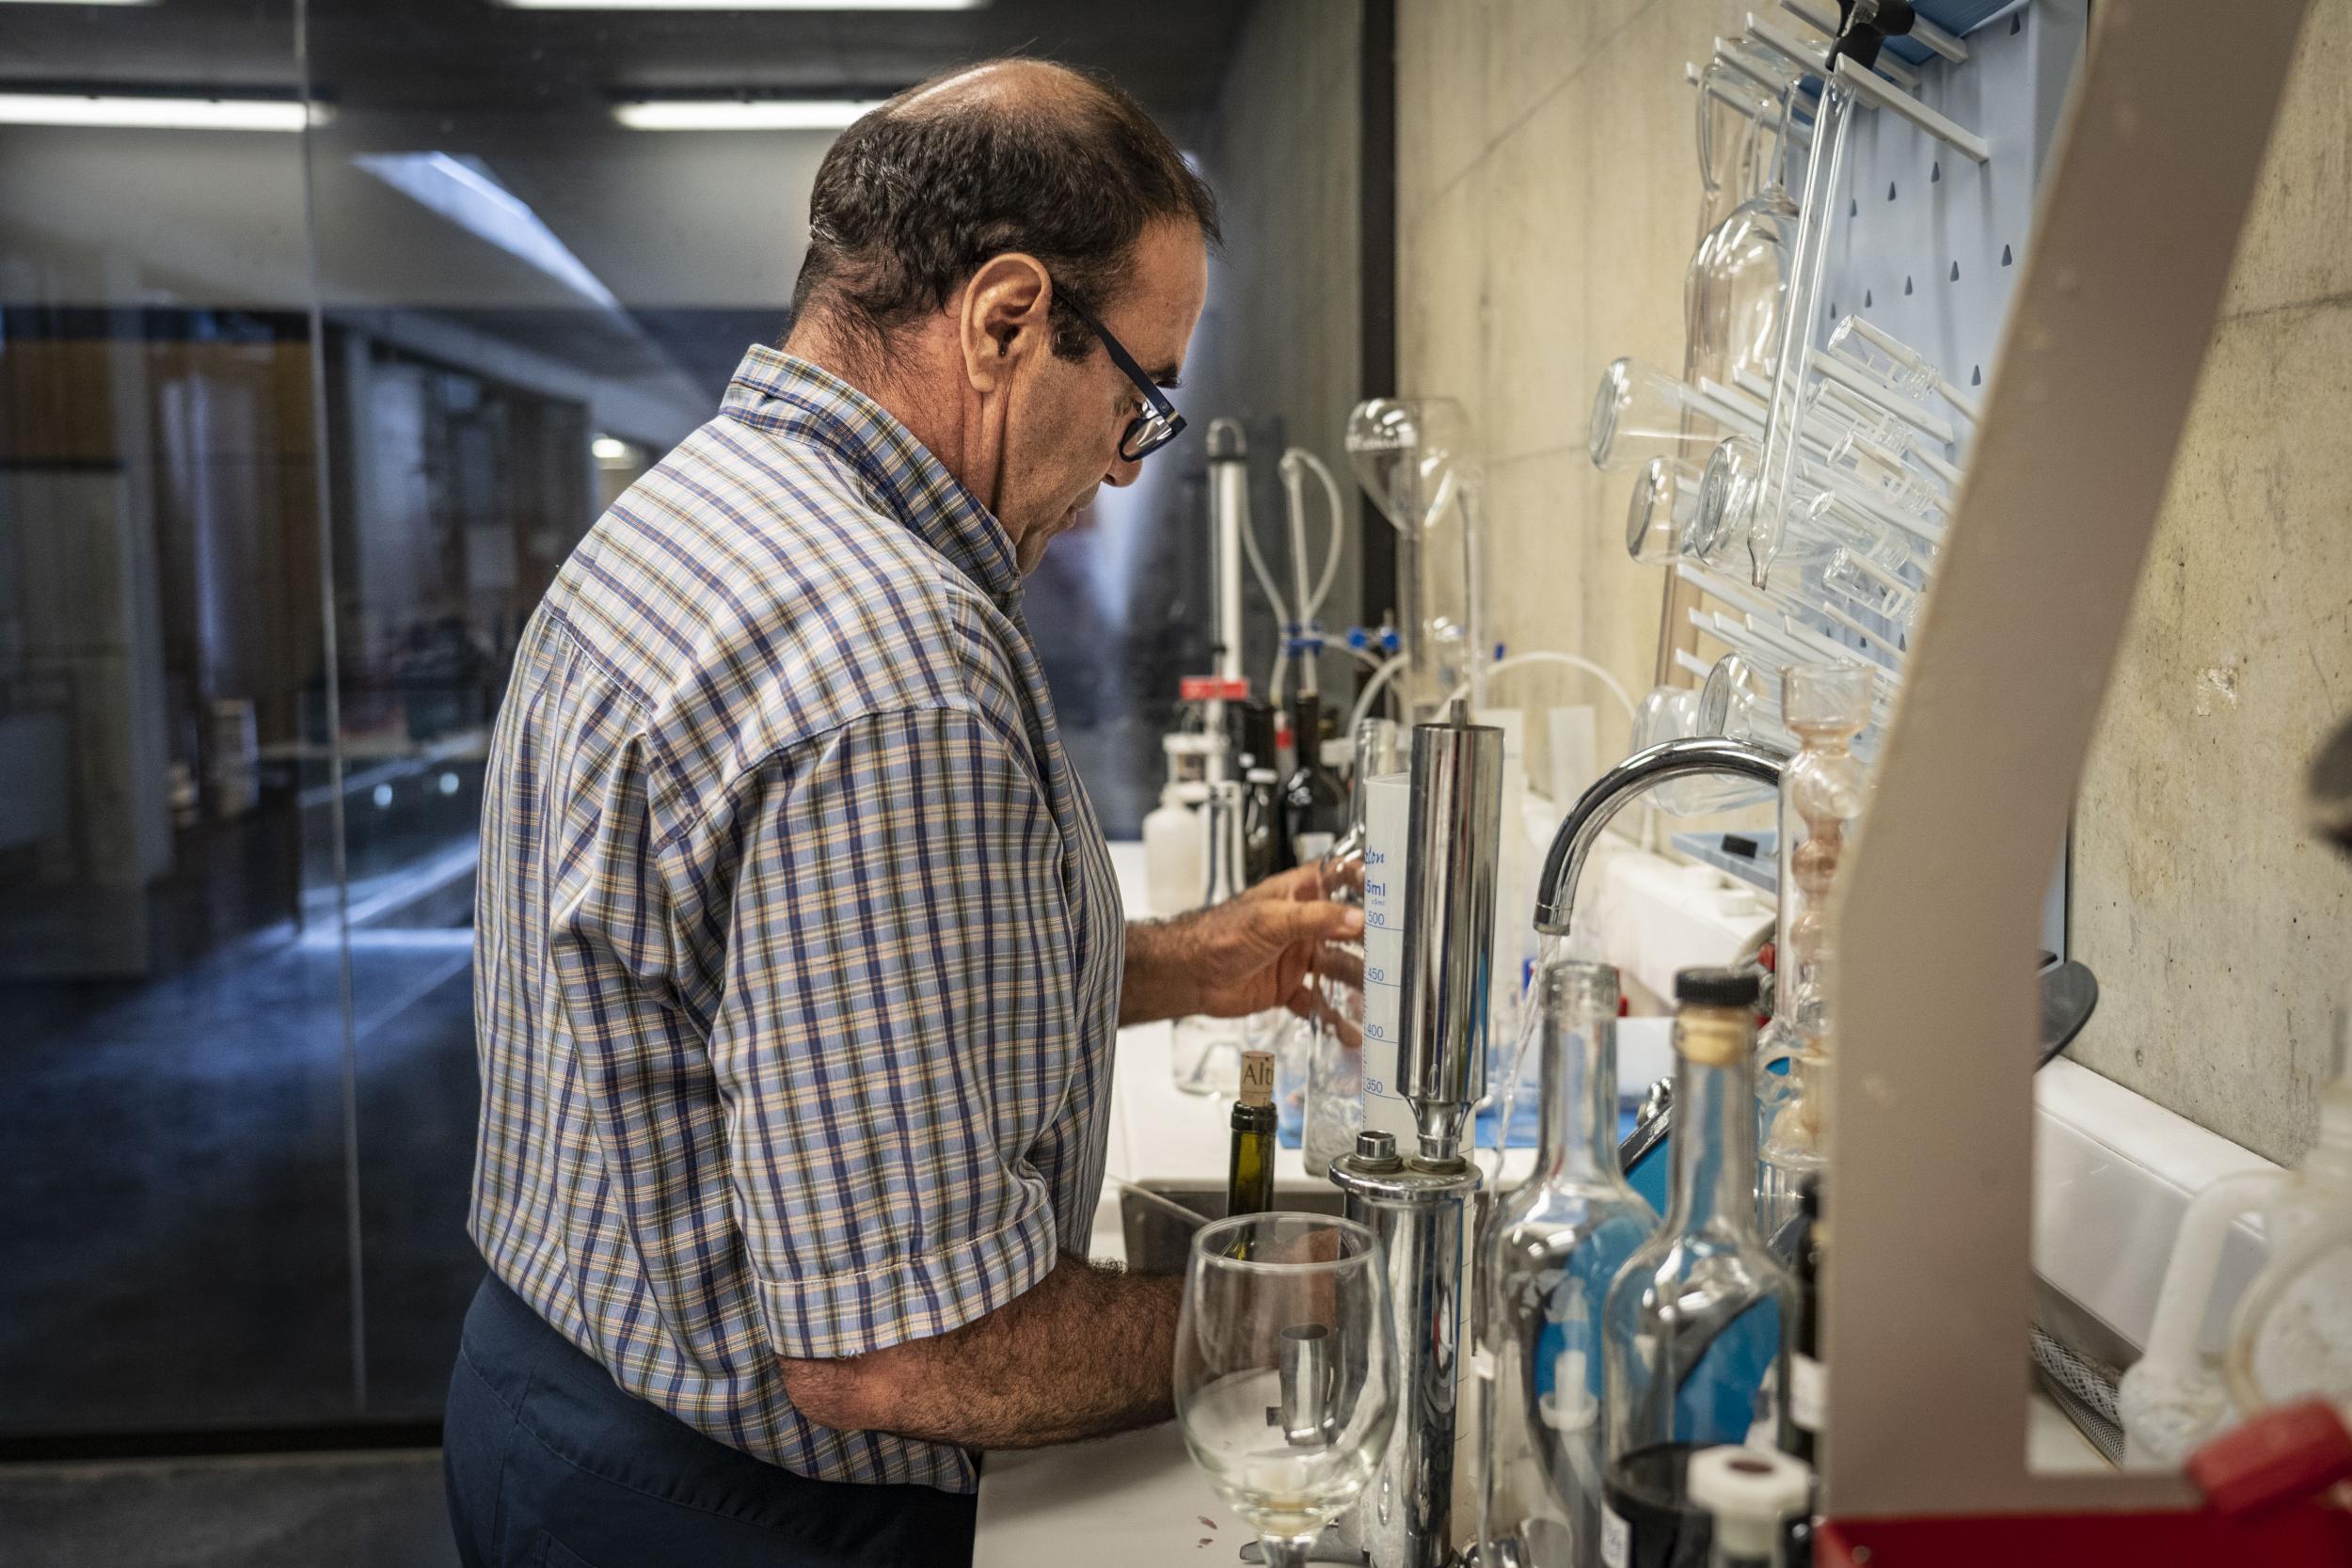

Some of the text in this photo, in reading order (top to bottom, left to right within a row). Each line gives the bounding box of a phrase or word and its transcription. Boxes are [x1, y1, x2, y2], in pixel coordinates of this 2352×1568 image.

[1368, 911, 1385, 926] 500
[1367, 967, 1384, 981] 450
[1367, 1022, 1384, 1038] 400
[1366, 1078, 1383, 1093] 350
